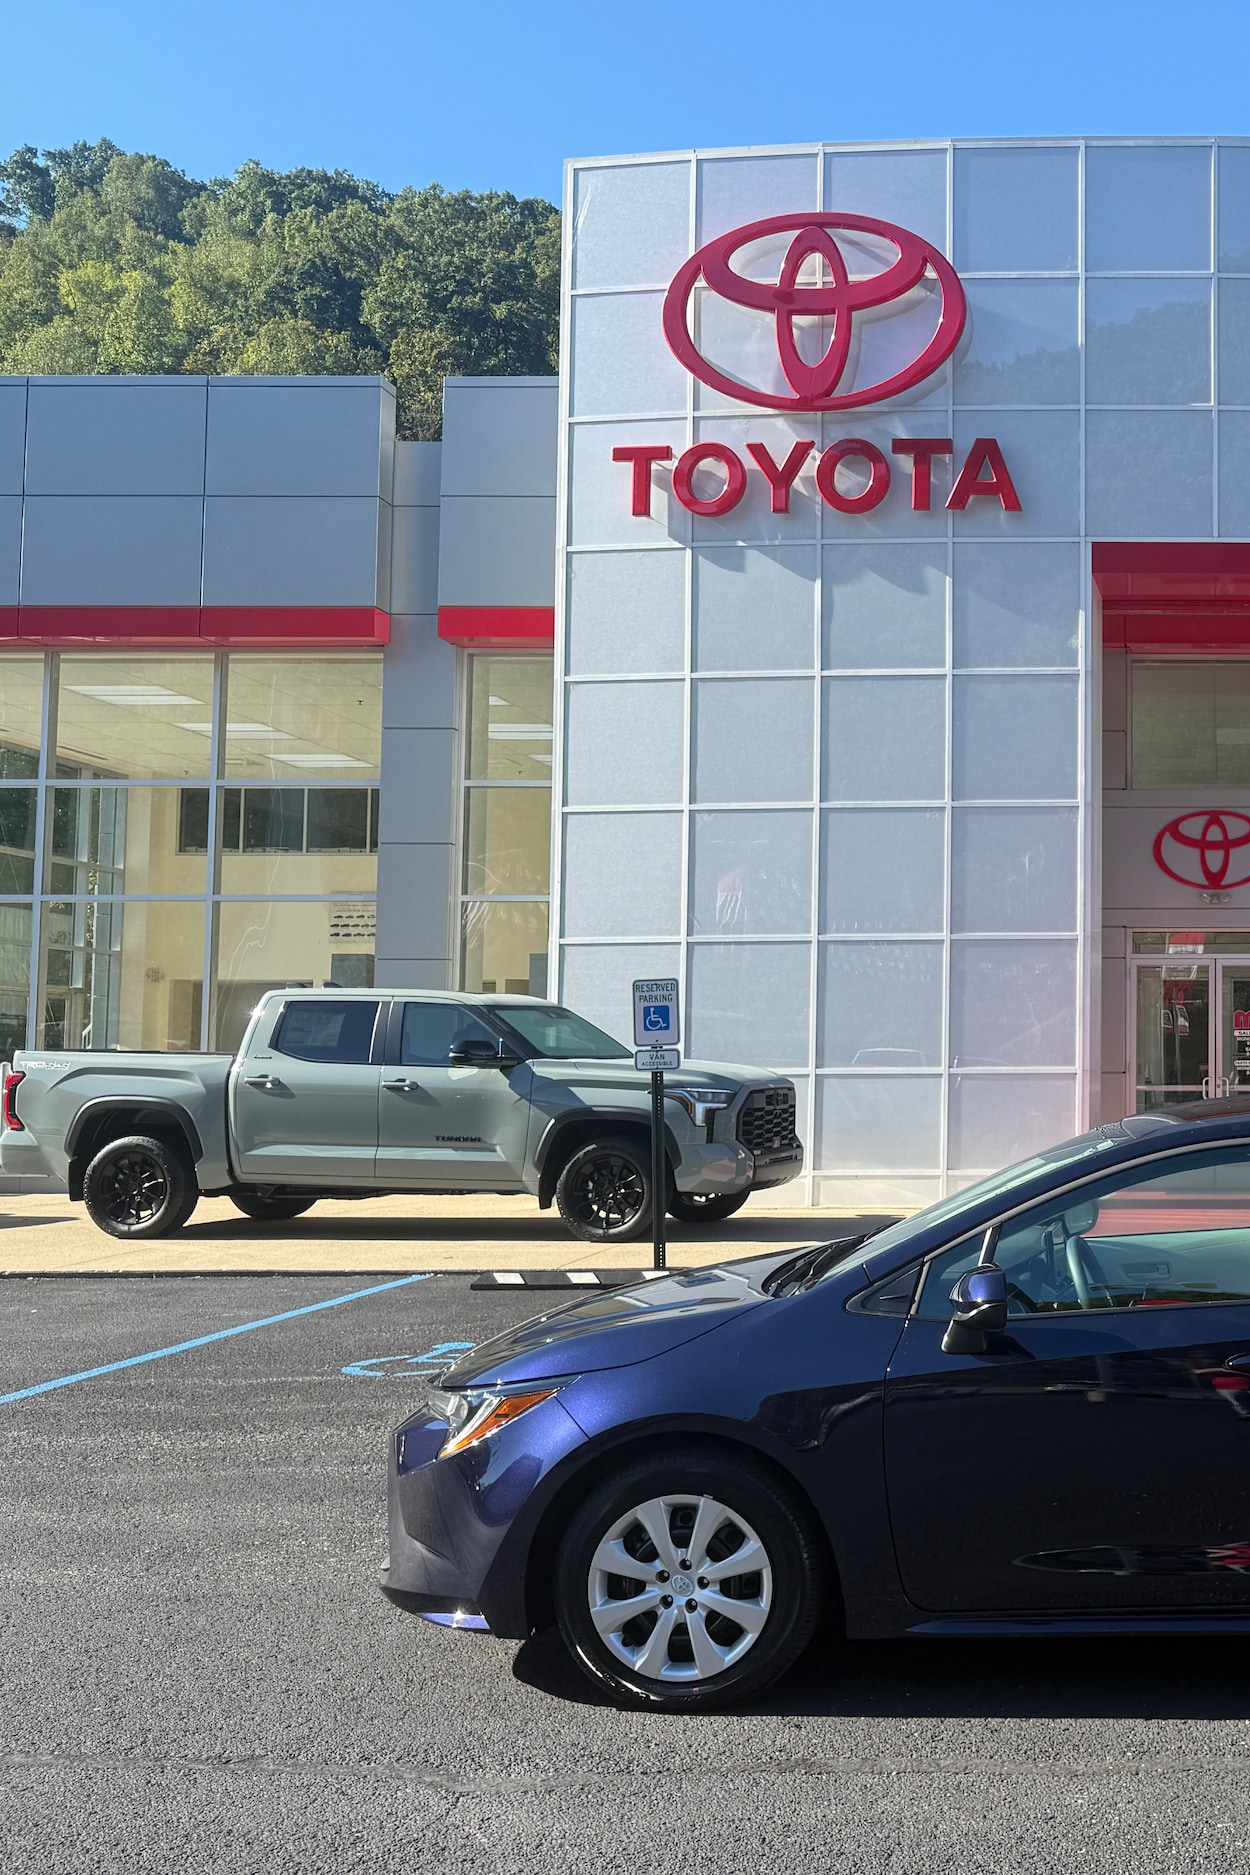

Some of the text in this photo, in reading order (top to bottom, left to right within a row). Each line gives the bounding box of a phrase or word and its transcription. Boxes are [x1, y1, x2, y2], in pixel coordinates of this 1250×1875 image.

[612, 438, 1022, 517] TOYOTA
[636, 983, 675, 992] RESERVED
[639, 993, 673, 1003] PARKING
